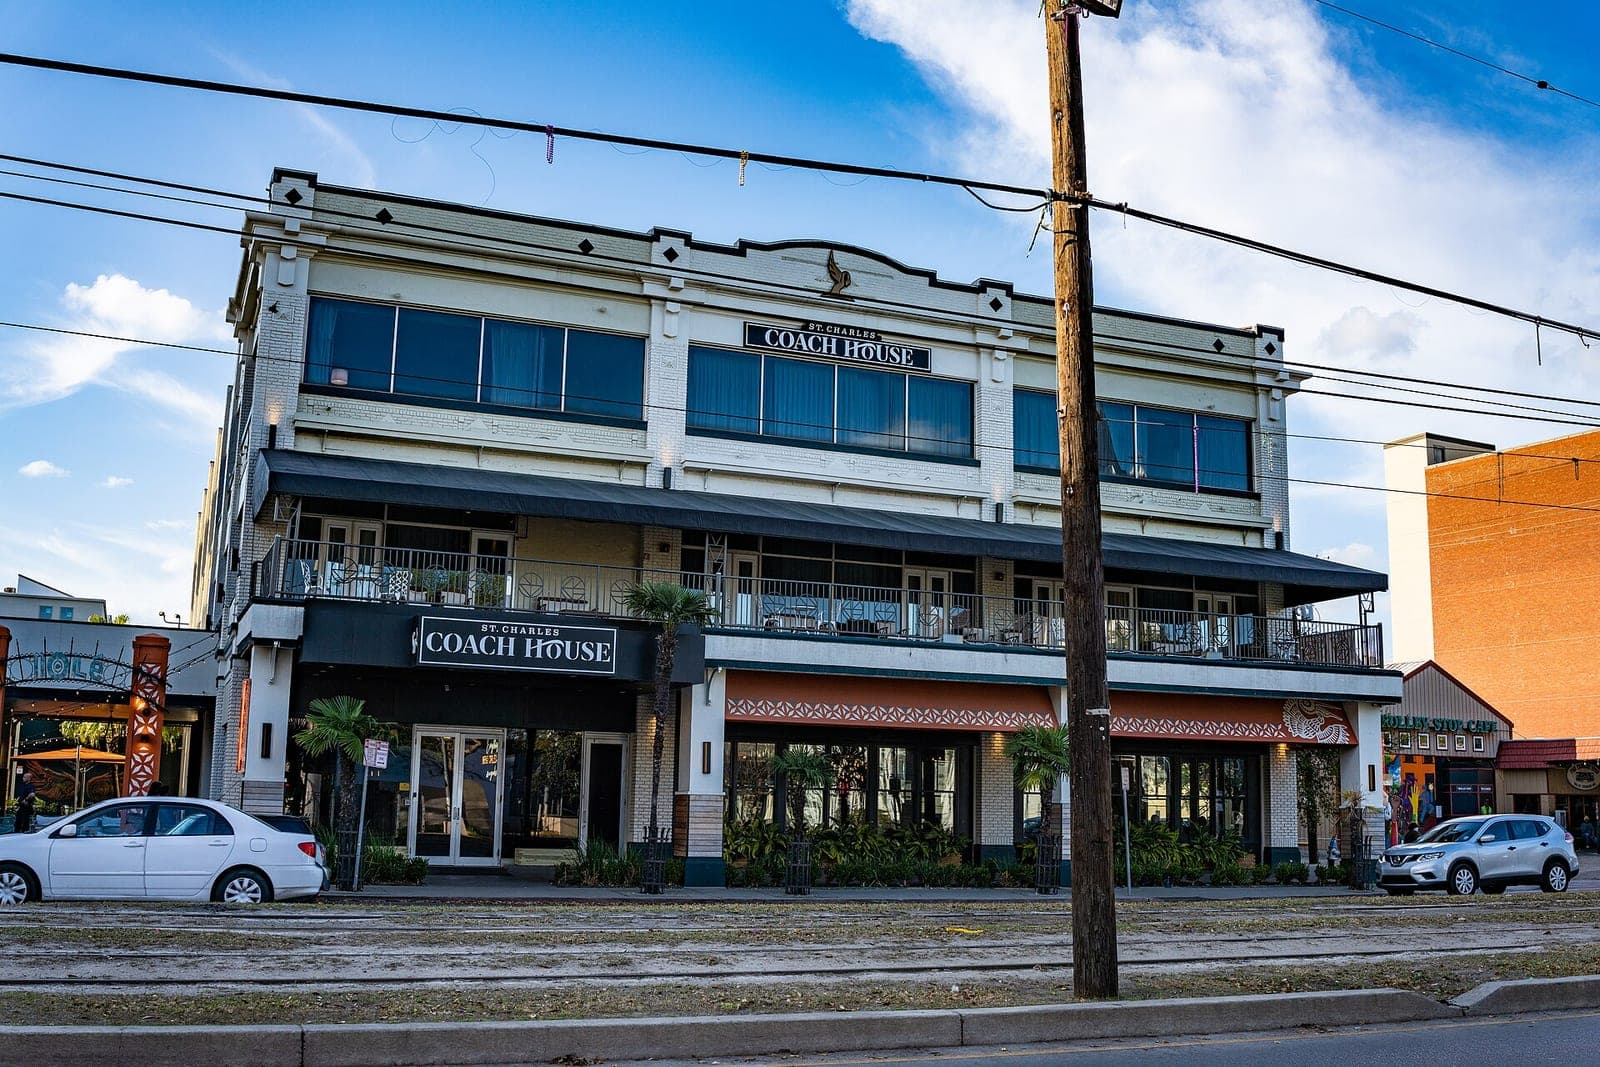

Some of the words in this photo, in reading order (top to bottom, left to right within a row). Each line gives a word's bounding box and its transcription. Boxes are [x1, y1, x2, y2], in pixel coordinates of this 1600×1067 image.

[808, 322, 824, 333] ST.
[826, 324, 877, 339] CHARLES
[764, 328, 836, 355] COACH
[844, 339, 914, 366] HOUSE
[481, 623, 499, 633] ST.
[502, 625, 560, 637] CHARLES
[425, 631, 515, 657] COACH
[524, 638, 611, 663] HOUSE
[1432, 718, 1463, 732] STOP
